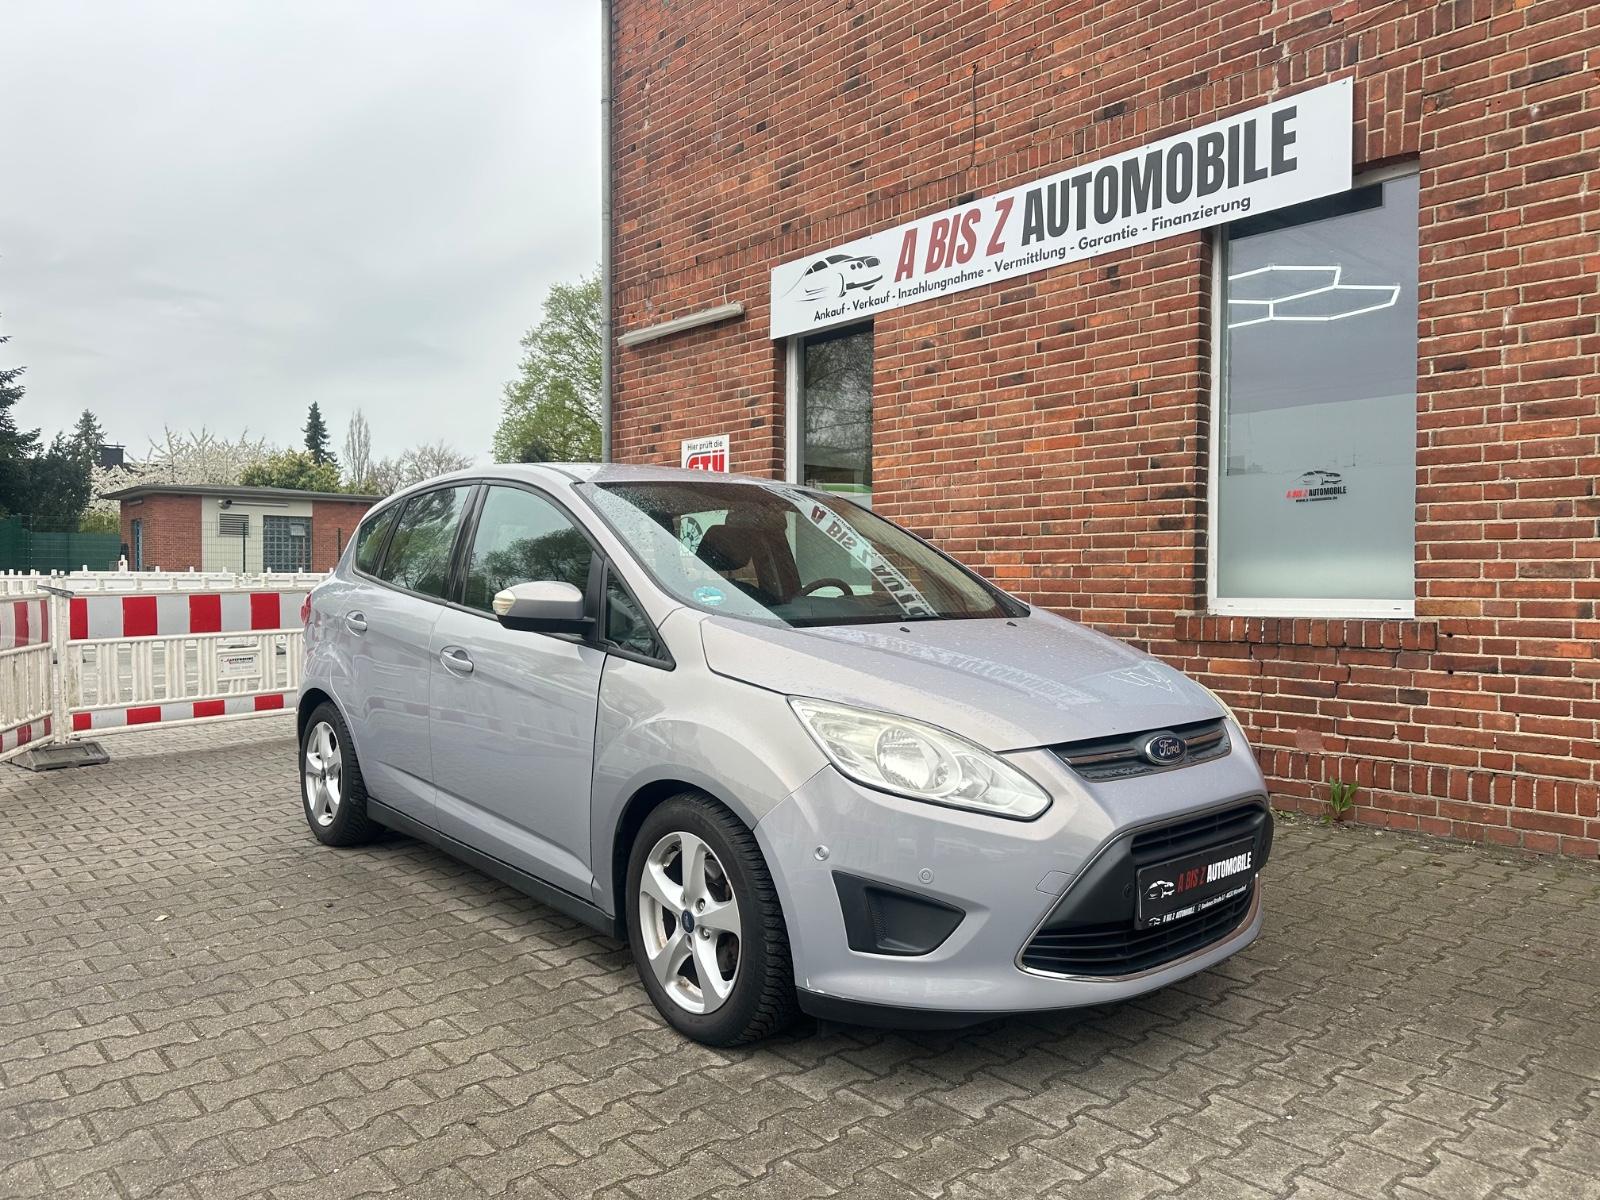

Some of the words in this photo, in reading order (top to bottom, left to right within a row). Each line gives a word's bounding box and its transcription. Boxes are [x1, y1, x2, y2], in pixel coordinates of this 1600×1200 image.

[894, 227, 918, 283] A
[924, 208, 981, 274] BIS
[985, 196, 1015, 257] Z
[1021, 105, 1298, 247] AUTOMOBILE
[814, 303, 846, 322] Ankauf
[852, 292, 891, 311] Verkauf
[898, 267, 984, 300] Inzahlungnahme
[994, 246, 1067, 274] Vermittlung
[1078, 225, 1138, 250] Garantie
[1151, 196, 1251, 232] Finanzierung
[687, 443, 699, 451] Hier
[1309, 486, 1347, 496] AUTOMOBILE
[1159, 739, 1180, 756] Ford
[1206, 852, 1252, 883] AUTOMOBILE
